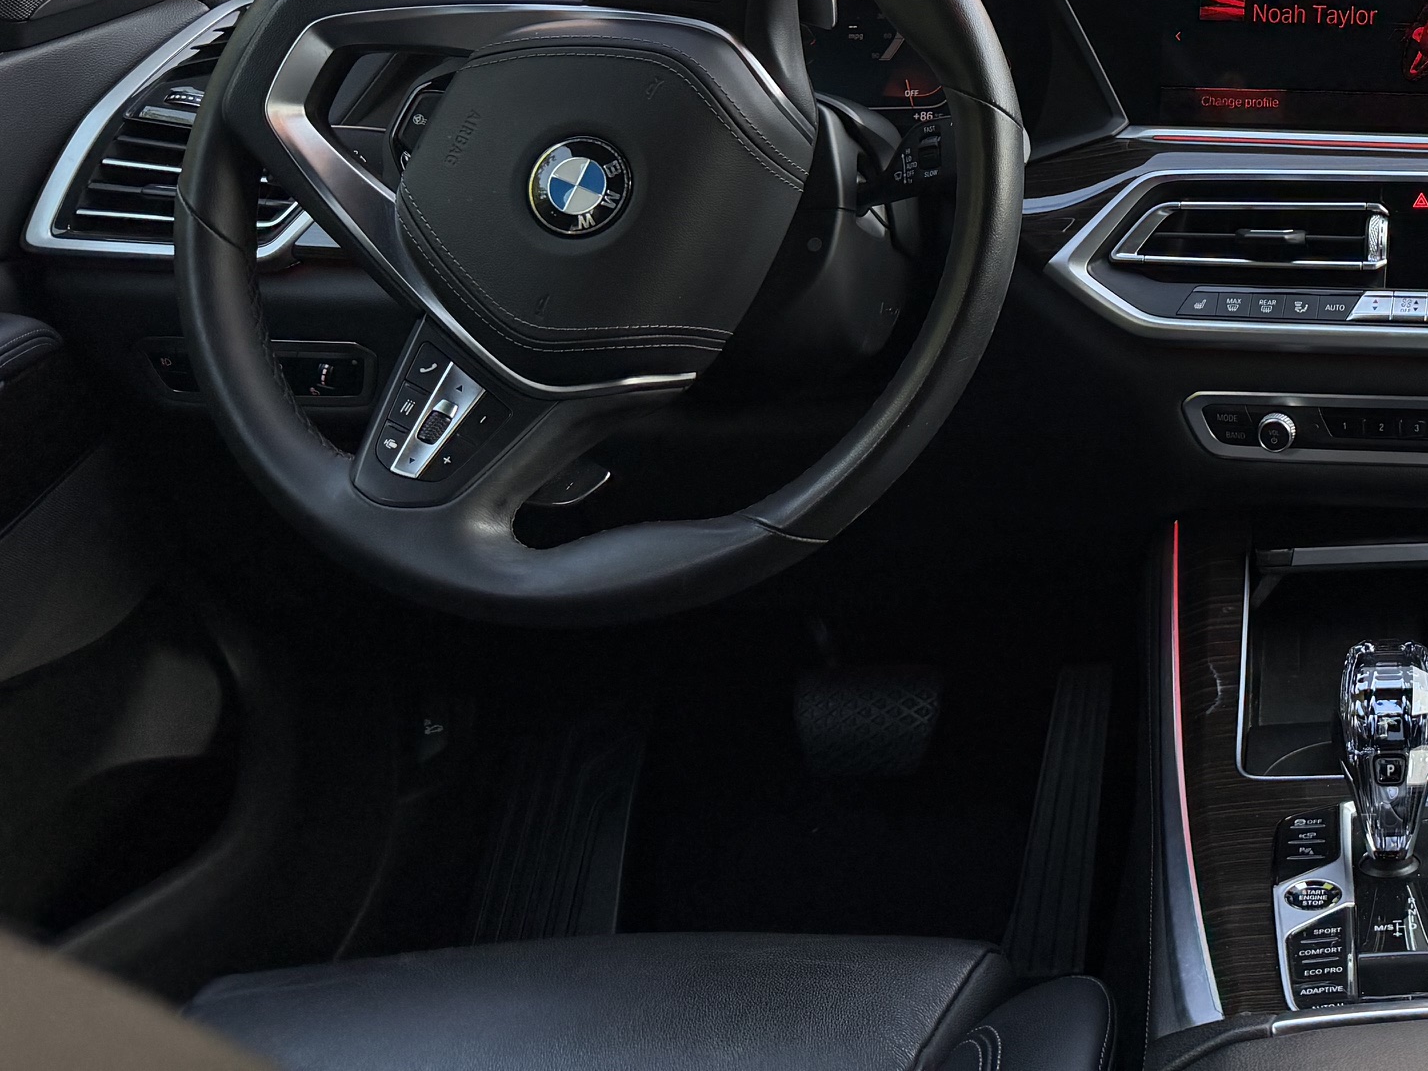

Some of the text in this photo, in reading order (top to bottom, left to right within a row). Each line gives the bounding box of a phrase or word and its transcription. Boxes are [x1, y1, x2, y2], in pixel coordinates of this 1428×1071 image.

[1253, 4, 1379, 29] Noah Taylor
[848, 33, 864, 41] mpg
[904, 90, 920, 98] OFF
[1201, 95, 1280, 109] Change profile
[913, 111, 934, 121] +86
[923, 125, 936, 133] FAST
[444, 109, 481, 168] AIRBAG
[906, 161, 918, 169] AUTO
[906, 170, 915, 178] OFF
[923, 169, 939, 178] SLOW
[1226, 298, 1243, 306] MAX
[1258, 299, 1278, 307] REAR
[1324, 303, 1346, 313] AUTO
[1216, 413, 1238, 423] MODE
[1343, 422, 1348, 430] 1
[1379, 423, 1385, 432] 2
[1414, 424, 1420, 433] 3
[1225, 430, 1246, 440] BAND
[1268, 429, 1280, 437] VOL
[1386, 764, 1395, 777] P
[1313, 926, 1342, 935] SPORT
[1373, 923, 1395, 932] M/S
[1298, 946, 1343, 956] COMFORT
[1304, 966, 1343, 977] ECO PRO
[1299, 985, 1344, 996] ADAPTIVE
